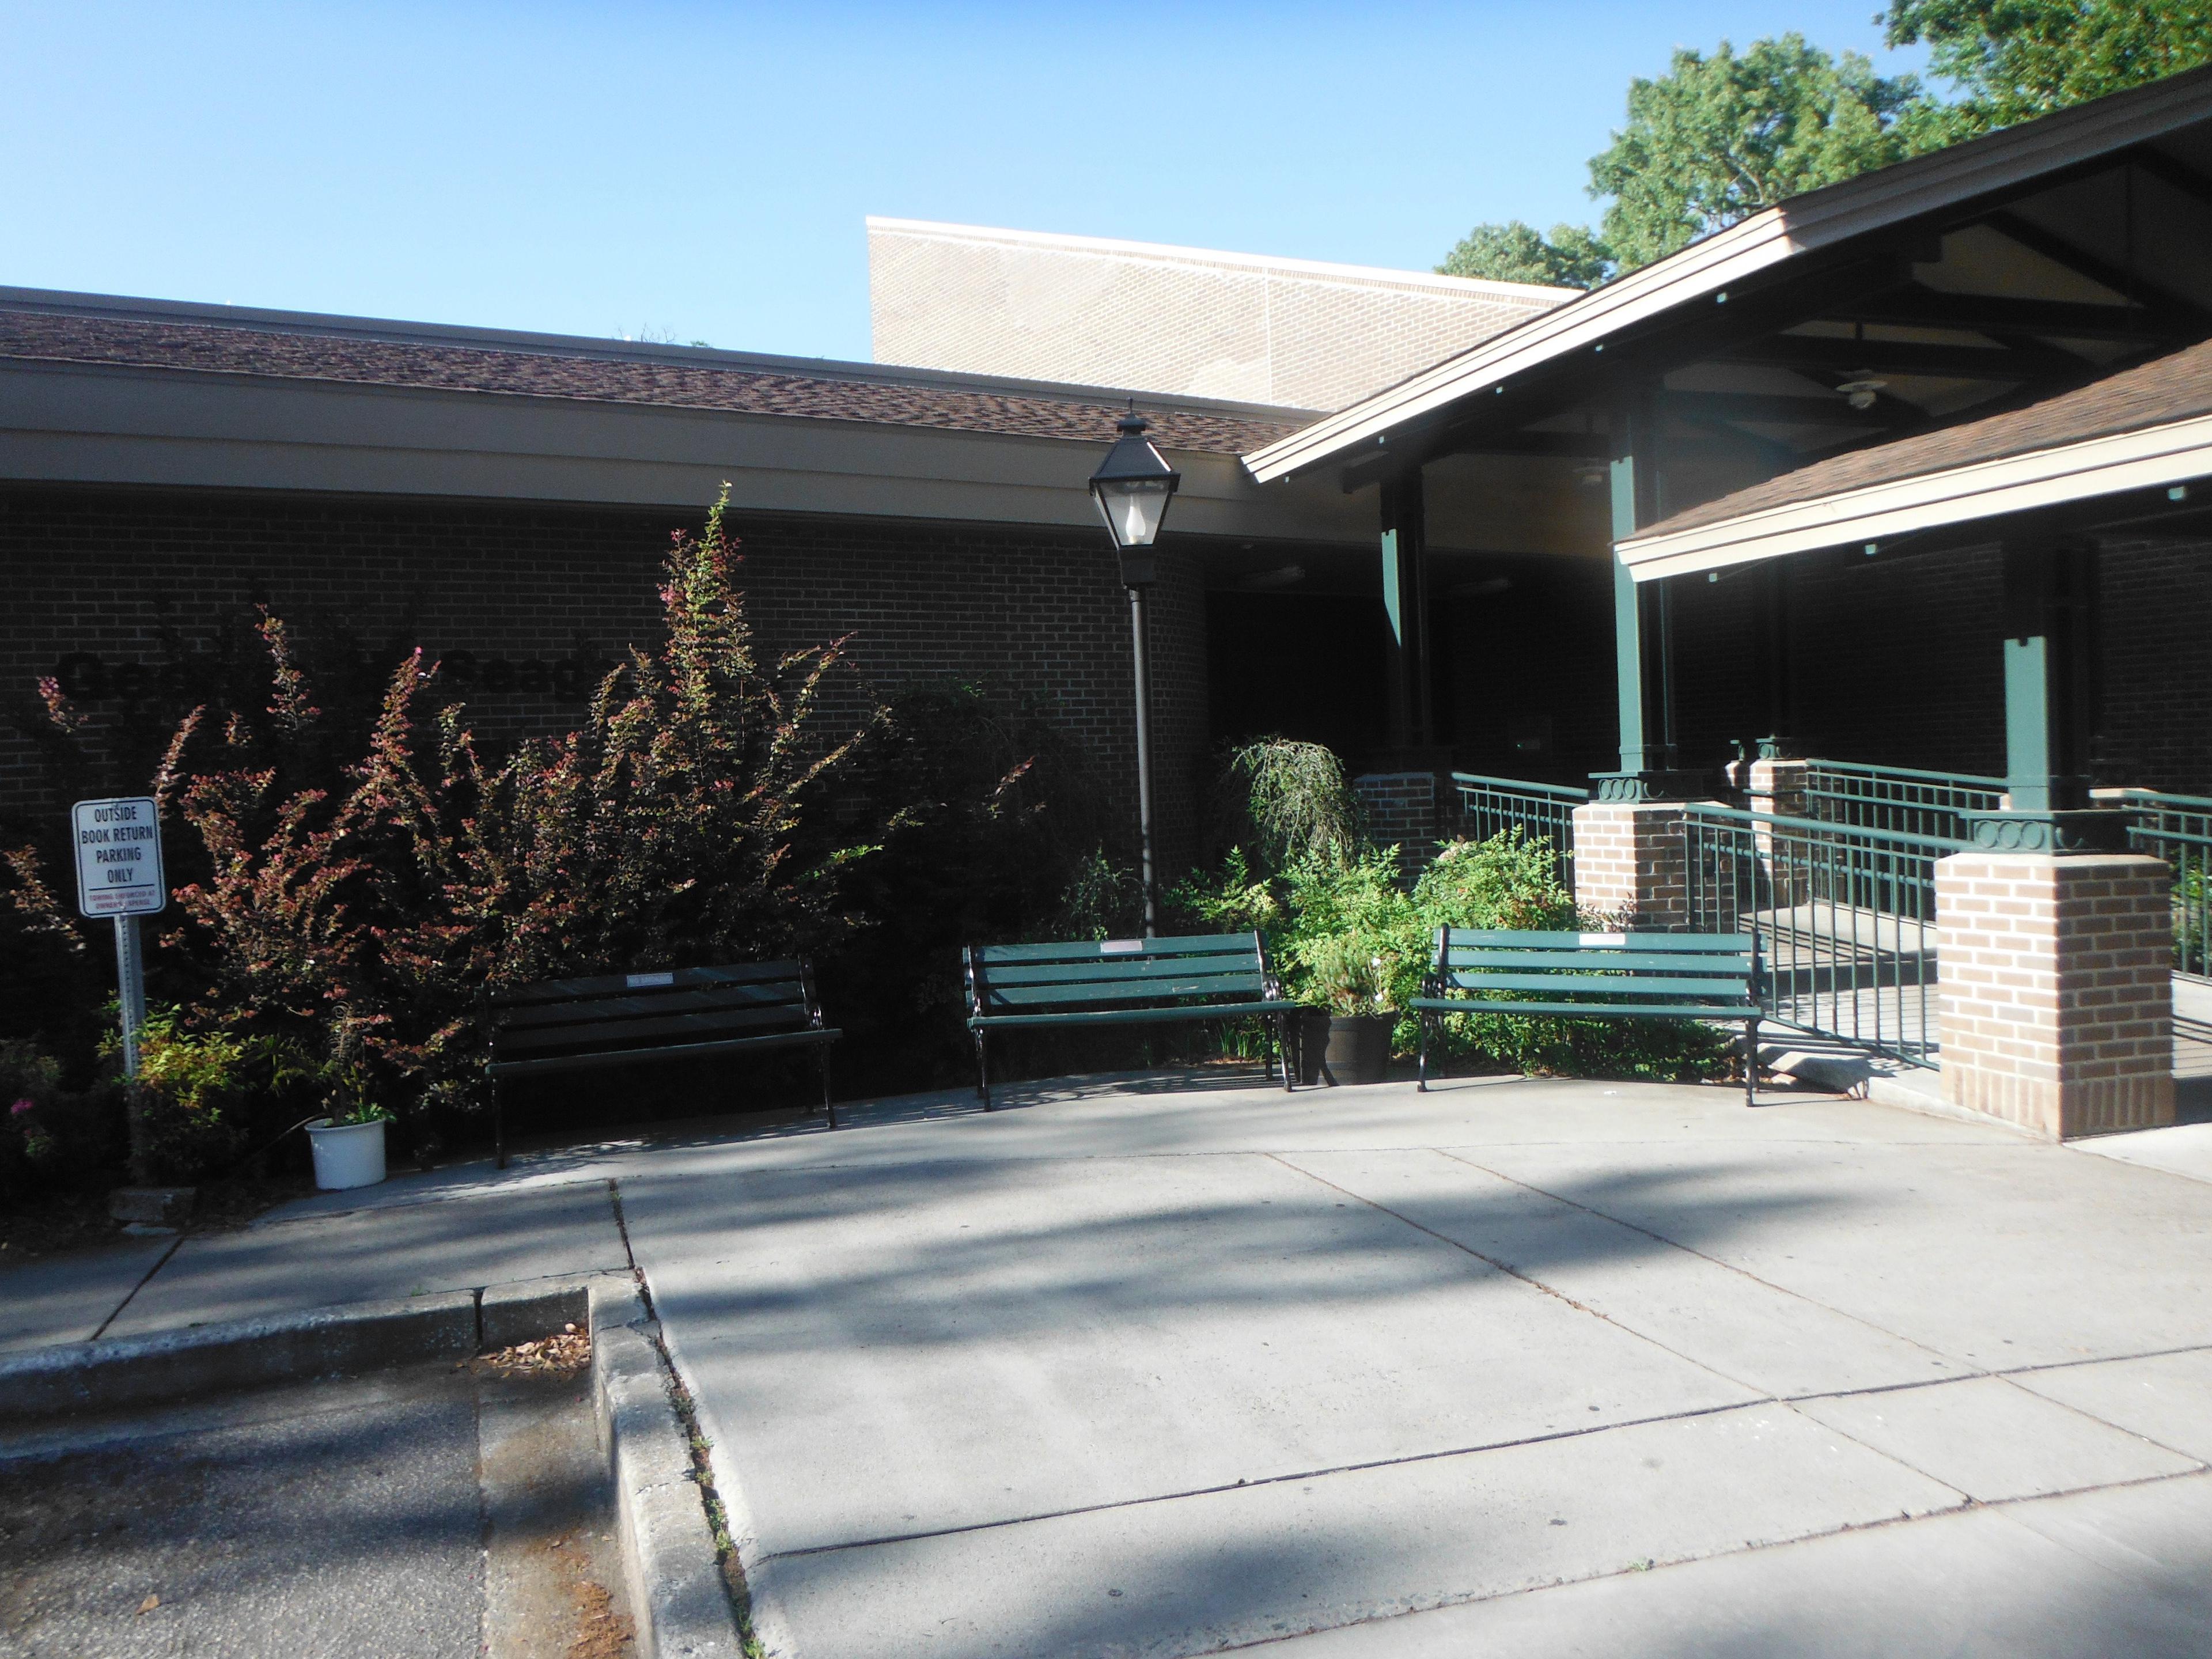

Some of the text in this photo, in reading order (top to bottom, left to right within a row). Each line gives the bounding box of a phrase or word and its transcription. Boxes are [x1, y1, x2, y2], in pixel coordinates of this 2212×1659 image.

[94, 806, 137, 823] OUTSIDE
[81, 825, 153, 844] BOOK RETURN
[96, 847, 141, 863] PARKING
[107, 868, 132, 883] ONLY
